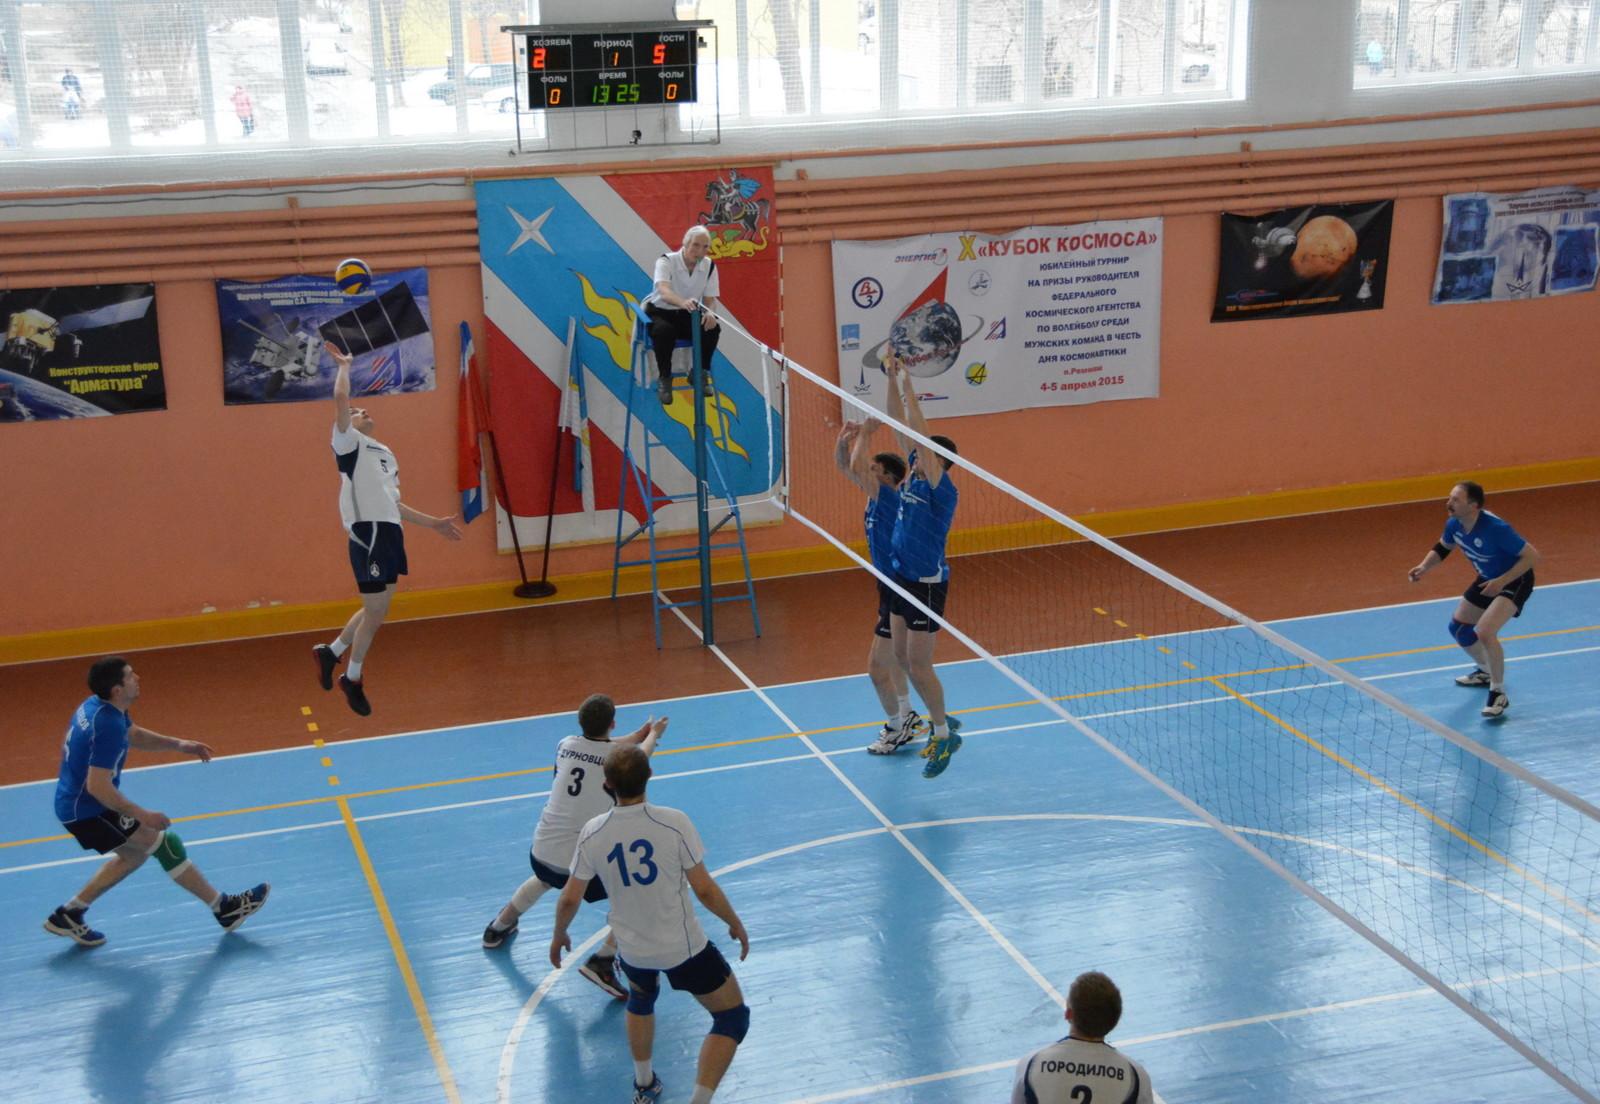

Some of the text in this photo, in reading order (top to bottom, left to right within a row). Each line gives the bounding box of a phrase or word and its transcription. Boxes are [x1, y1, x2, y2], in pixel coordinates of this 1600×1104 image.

[532, 38, 572, 46] ХОЗЯЕВА
[594, 39, 633, 49] период
[659, 34, 685, 42] ГОСТИ
[532, 48, 546, 68] 2
[612, 52, 620, 66] 1
[652, 44, 666, 64] 5
[598, 72, 627, 80] ВРЕМЯ
[550, 88, 561, 105] 0
[666, 84, 678, 100] 0
[978, 237, 1050, 257] «КУБОК
[1057, 231, 1157, 252] КОСМОСА»
[1040, 257, 1130, 271] ЮБИЛЕЙНЫЙ ТУРНИР
[1028, 271, 1139, 287] НА ПРИЗЫ РУКОВОДИТЕЛЯ
[1052, 288, 1116, 301] ФЕДЕРАЛЬНОГО
[1026, 302, 1141, 318] КОСМИЧЕСКОГО АГЕНТСТВА
[1037, 318, 1129, 332] ПО ВОЛЕЙБОЛУ СРЕДИ
[1025, 340, 1069, 348] МУЖСКИХ
[1072, 336, 1104, 345] КОМАНД
[1115, 332, 1141, 340] ЧЕСТЬ
[1038, 348, 1126, 364] ДНЯ КОСМОНАВТИКИ
[49, 362, 159, 377] Конструкторское бюро
[1040, 376, 1124, 392] 4-5 апреля 2015
[567, 767, 585, 796] 3
[607, 838, 658, 887] 13
[1041, 1060, 1125, 1081] ГОРОДИЛОВ
